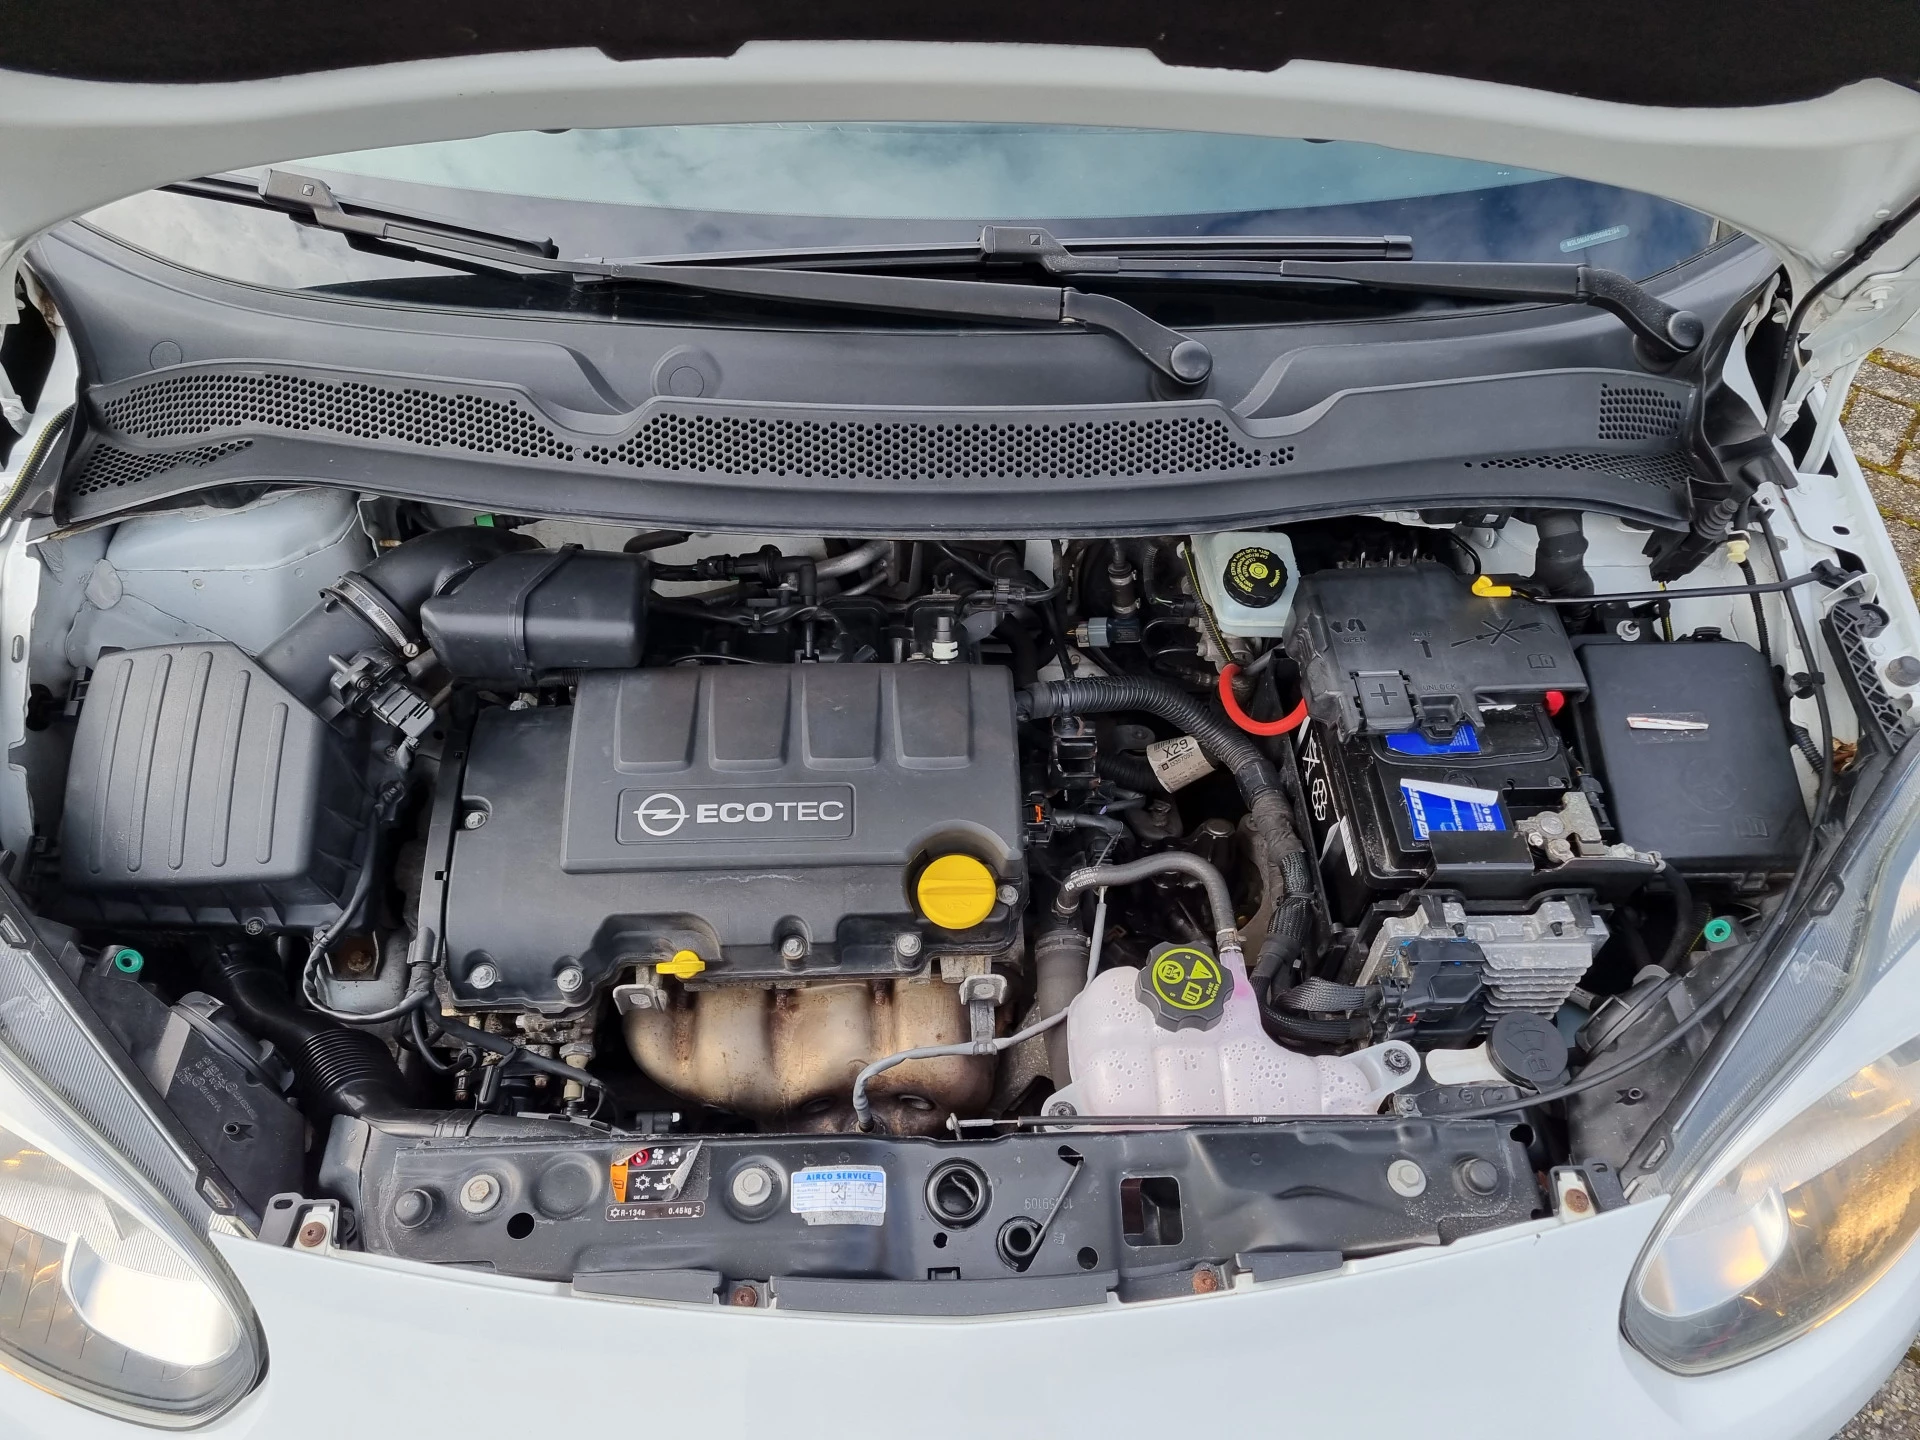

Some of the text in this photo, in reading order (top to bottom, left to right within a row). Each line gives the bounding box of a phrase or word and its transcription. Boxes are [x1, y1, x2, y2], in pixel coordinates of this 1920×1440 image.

[1162, 739, 1189, 758] X29
[696, 801, 844, 823] ECOTEC
[837, 1172, 872, 1180] SERVICE
